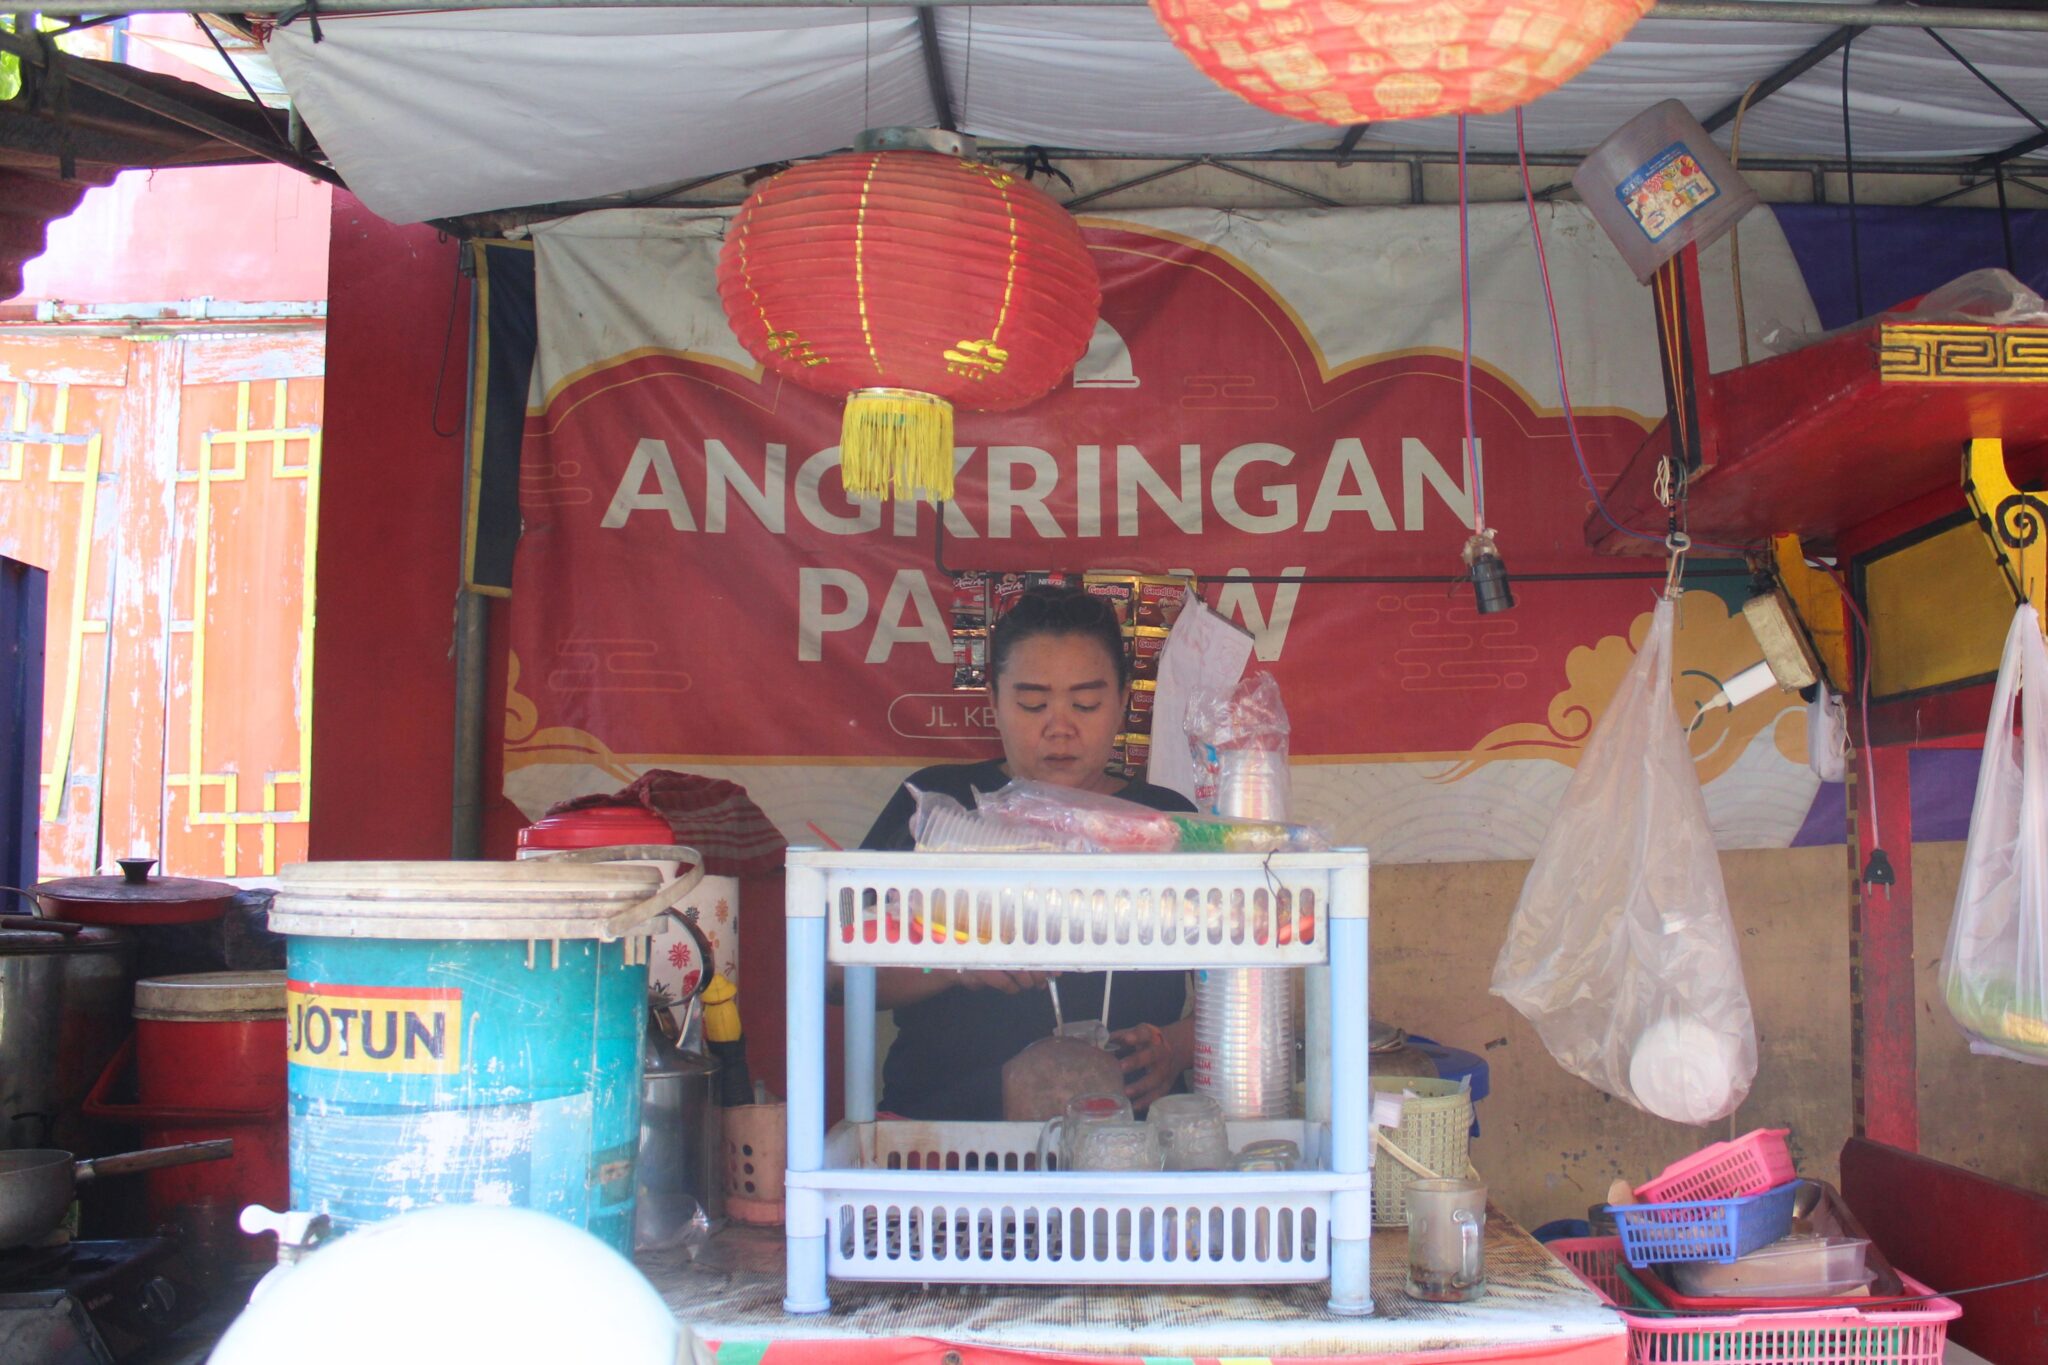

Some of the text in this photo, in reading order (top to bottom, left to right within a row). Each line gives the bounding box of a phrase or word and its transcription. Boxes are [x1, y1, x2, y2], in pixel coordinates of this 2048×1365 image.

[600, 438, 1485, 539] ANGKRINGAN
[925, 706, 957, 727] JL.
[294, 1004, 445, 1059] JOTUN
